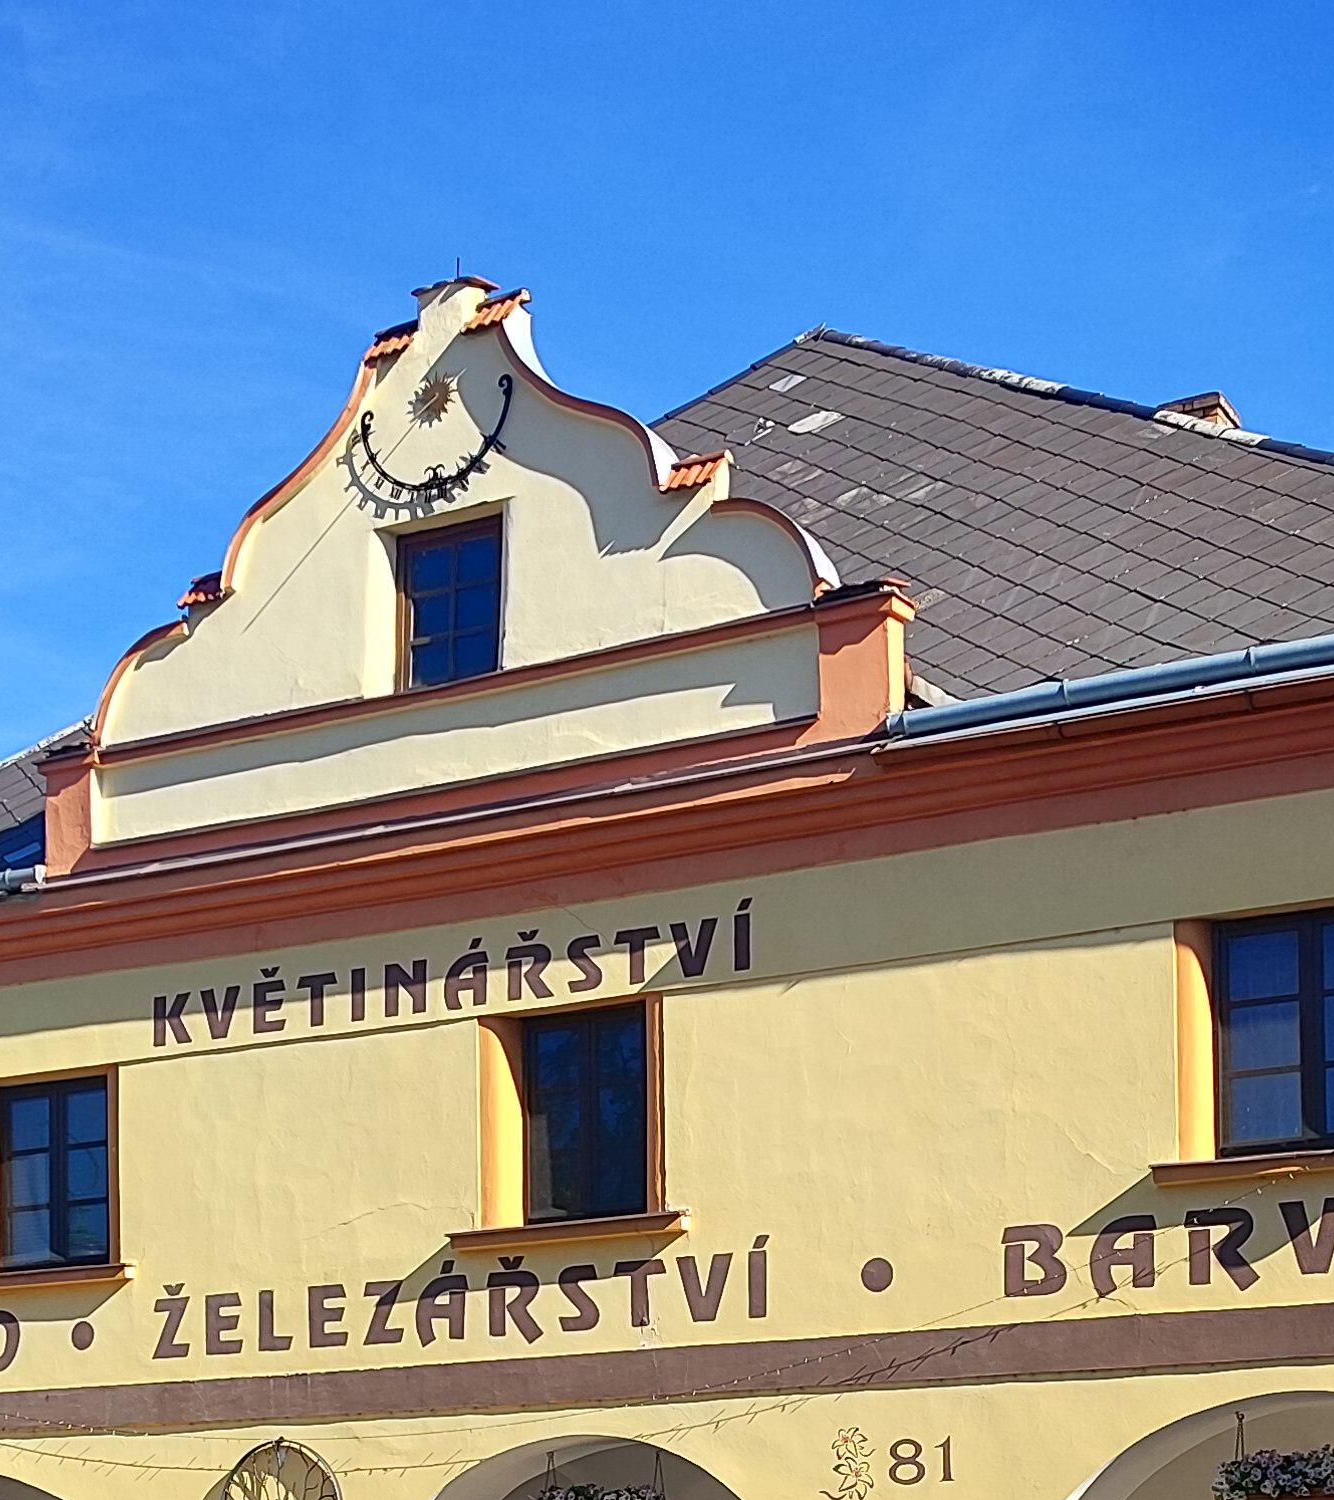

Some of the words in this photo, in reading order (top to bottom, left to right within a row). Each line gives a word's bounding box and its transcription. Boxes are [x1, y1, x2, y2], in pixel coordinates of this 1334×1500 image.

[153, 897, 753, 1047] KVĚTINÁŘSTVÍ
[152, 1234, 770, 1359] ŽELEZÁŘSTVÍ
[888, 1435, 955, 1486] 81
